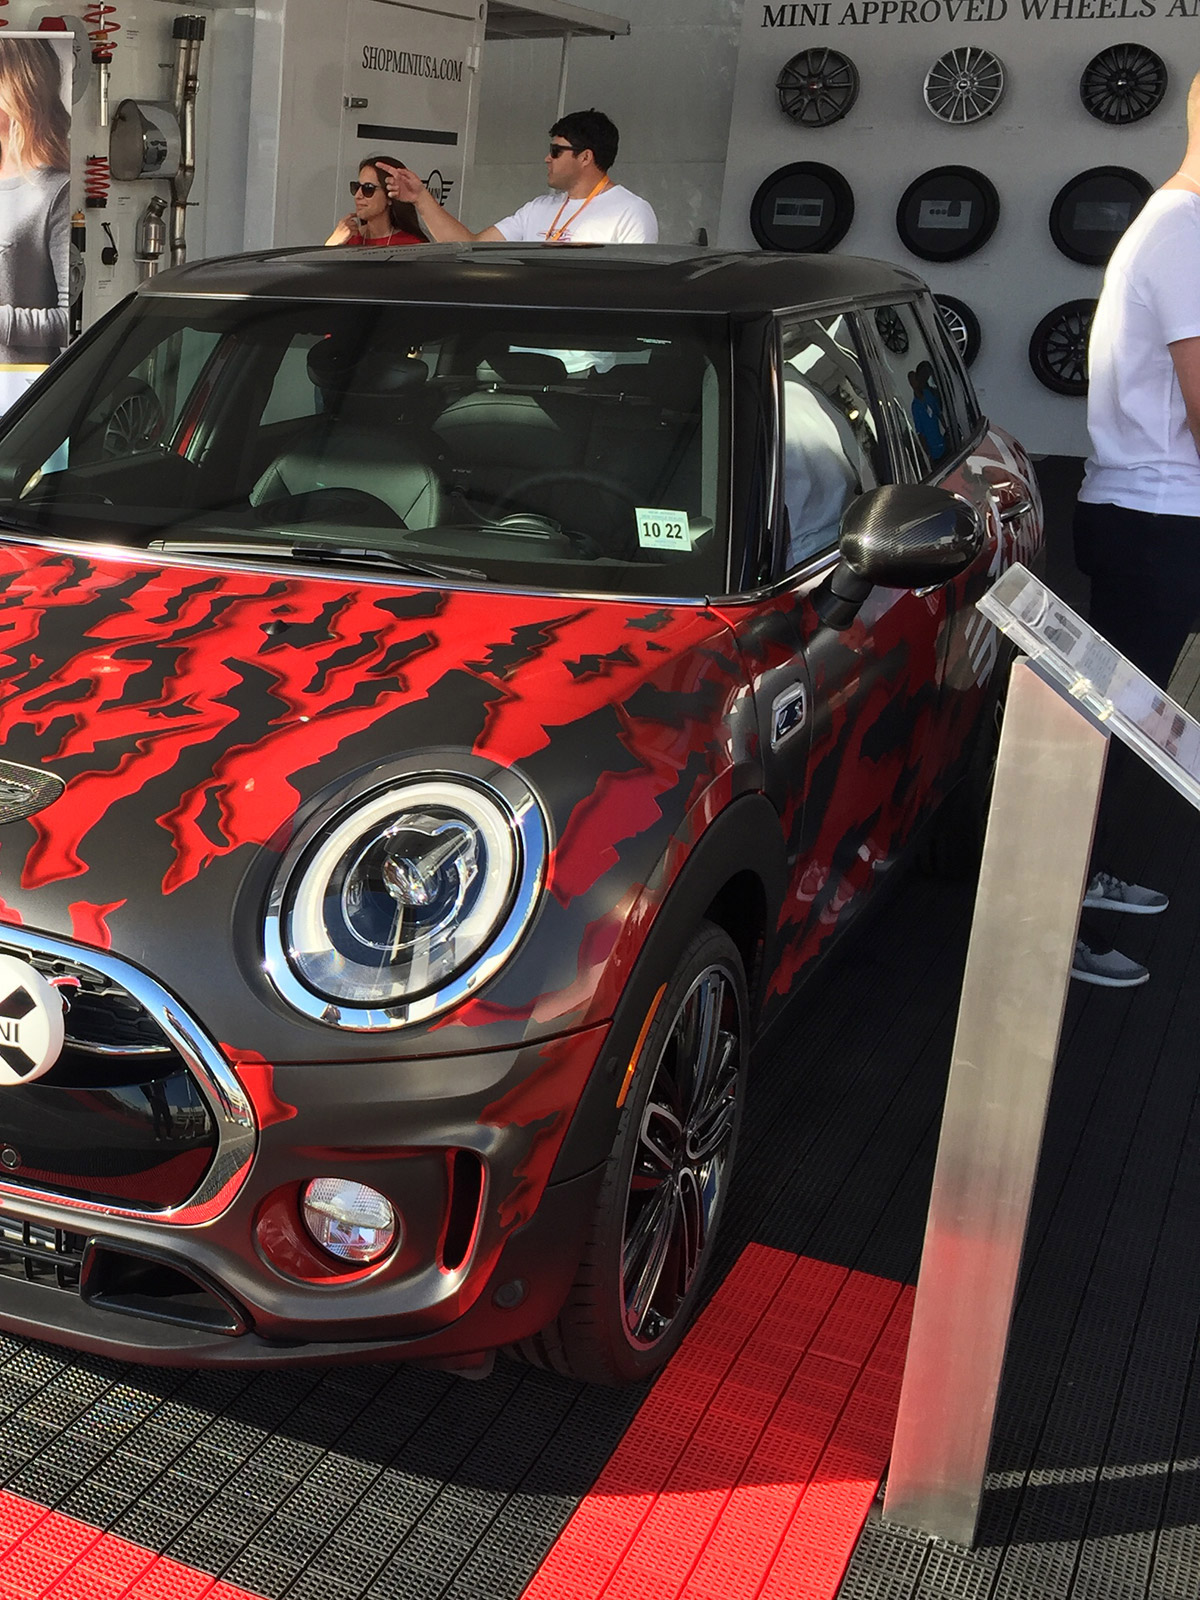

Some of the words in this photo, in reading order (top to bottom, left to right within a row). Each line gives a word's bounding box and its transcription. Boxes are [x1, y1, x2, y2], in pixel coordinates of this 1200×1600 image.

[761, 3, 832, 27] MINI
[838, 0, 1008, 25] APPROVED
[1021, 0, 1156, 20] WHEELS
[362, 45, 463, 82] SHOPMINIUSA.COM
[643, 522, 661, 538] 10
[665, 523, 683, 539] 22
